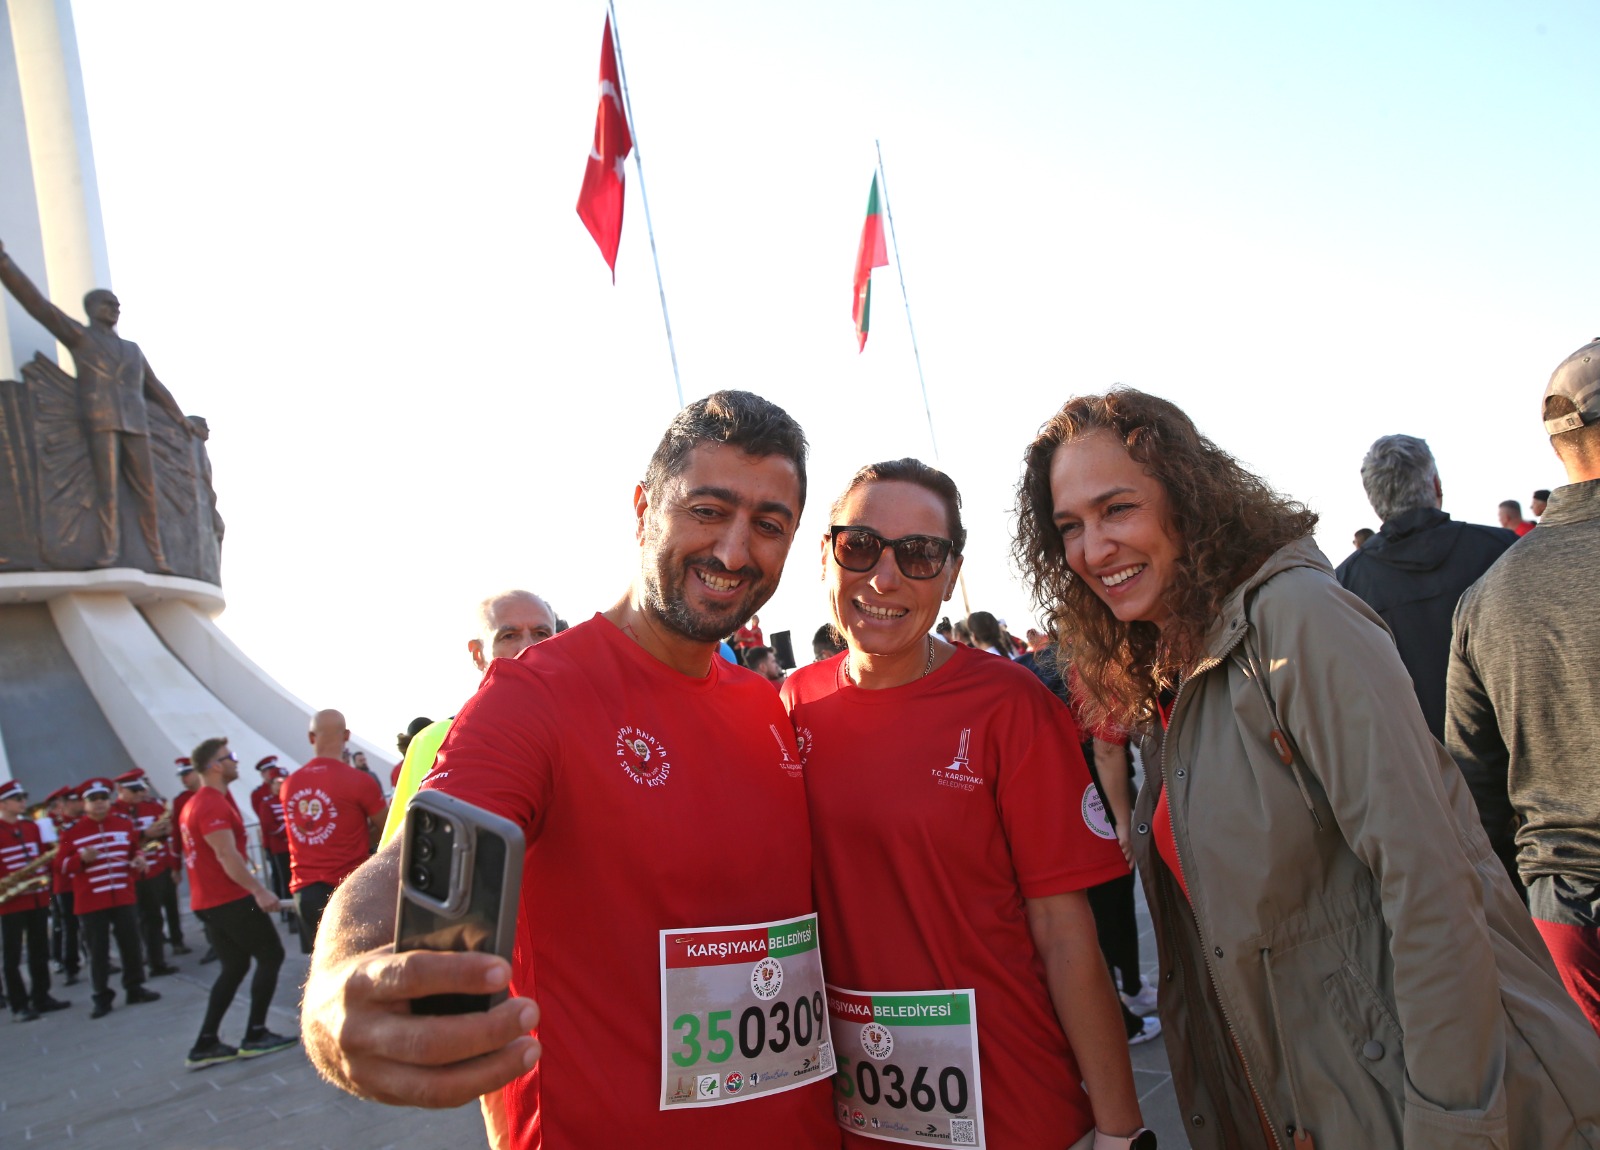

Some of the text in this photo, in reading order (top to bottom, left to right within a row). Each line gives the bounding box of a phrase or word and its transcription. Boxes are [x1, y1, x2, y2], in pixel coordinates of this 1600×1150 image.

[687, 929, 812, 958] KARŞIYAKA BELEDİYESİ
[671, 990, 824, 1067] 350309
[873, 1002, 951, 1017] BELEDİYESİ
[836, 1055, 968, 1114] 50360
